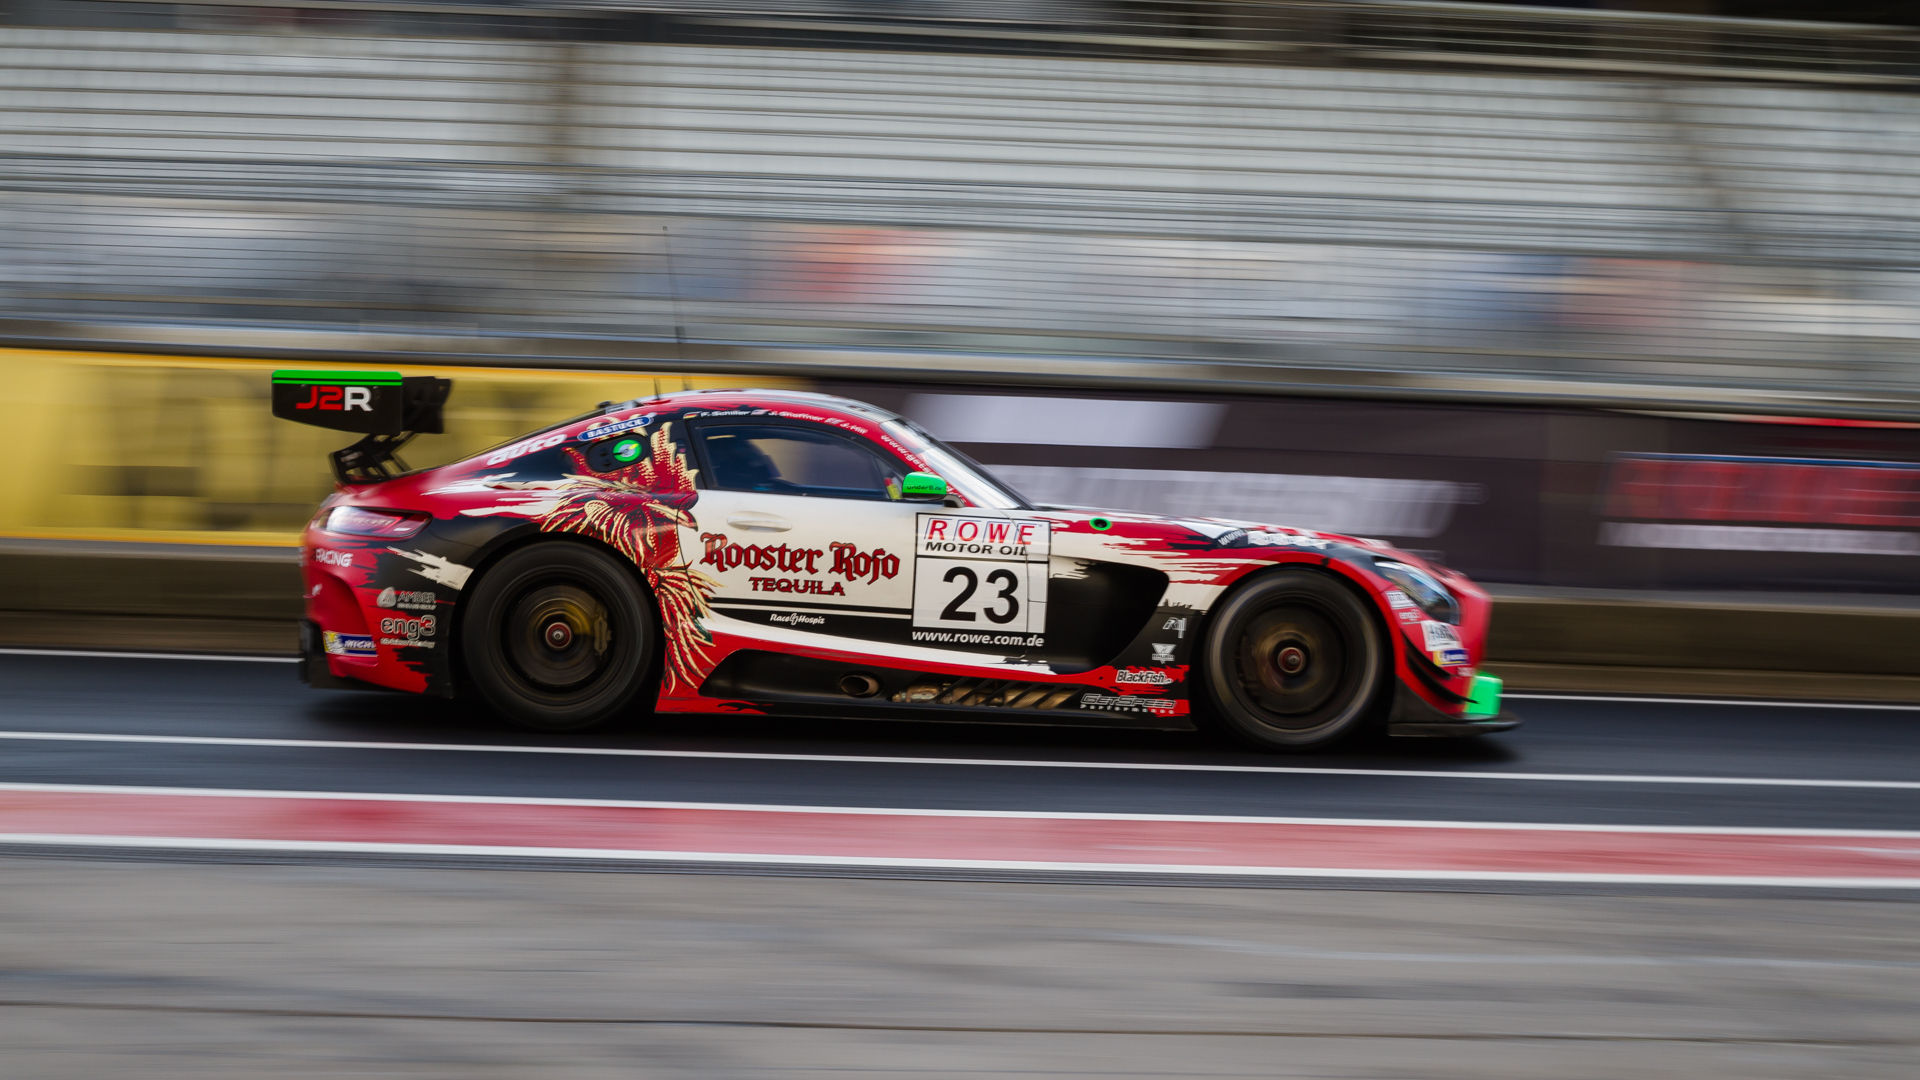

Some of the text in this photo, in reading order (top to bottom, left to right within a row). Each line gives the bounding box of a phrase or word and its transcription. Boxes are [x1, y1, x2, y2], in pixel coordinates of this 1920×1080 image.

[296, 385, 373, 411] J2R
[586, 418, 645, 439] BASTUCK
[486, 433, 567, 466] auto
[927, 519, 1036, 545] ROWE
[315, 548, 354, 568] RACING
[699, 532, 901, 585] Rooster Rojo
[925, 541, 1028, 556] MOTOR OIL
[397, 591, 436, 604] AMBER
[748, 577, 846, 597] TEQUILA
[939, 566, 1020, 624] 23
[380, 614, 437, 641] eng3
[911, 630, 1045, 647] www.rowe.com.de
